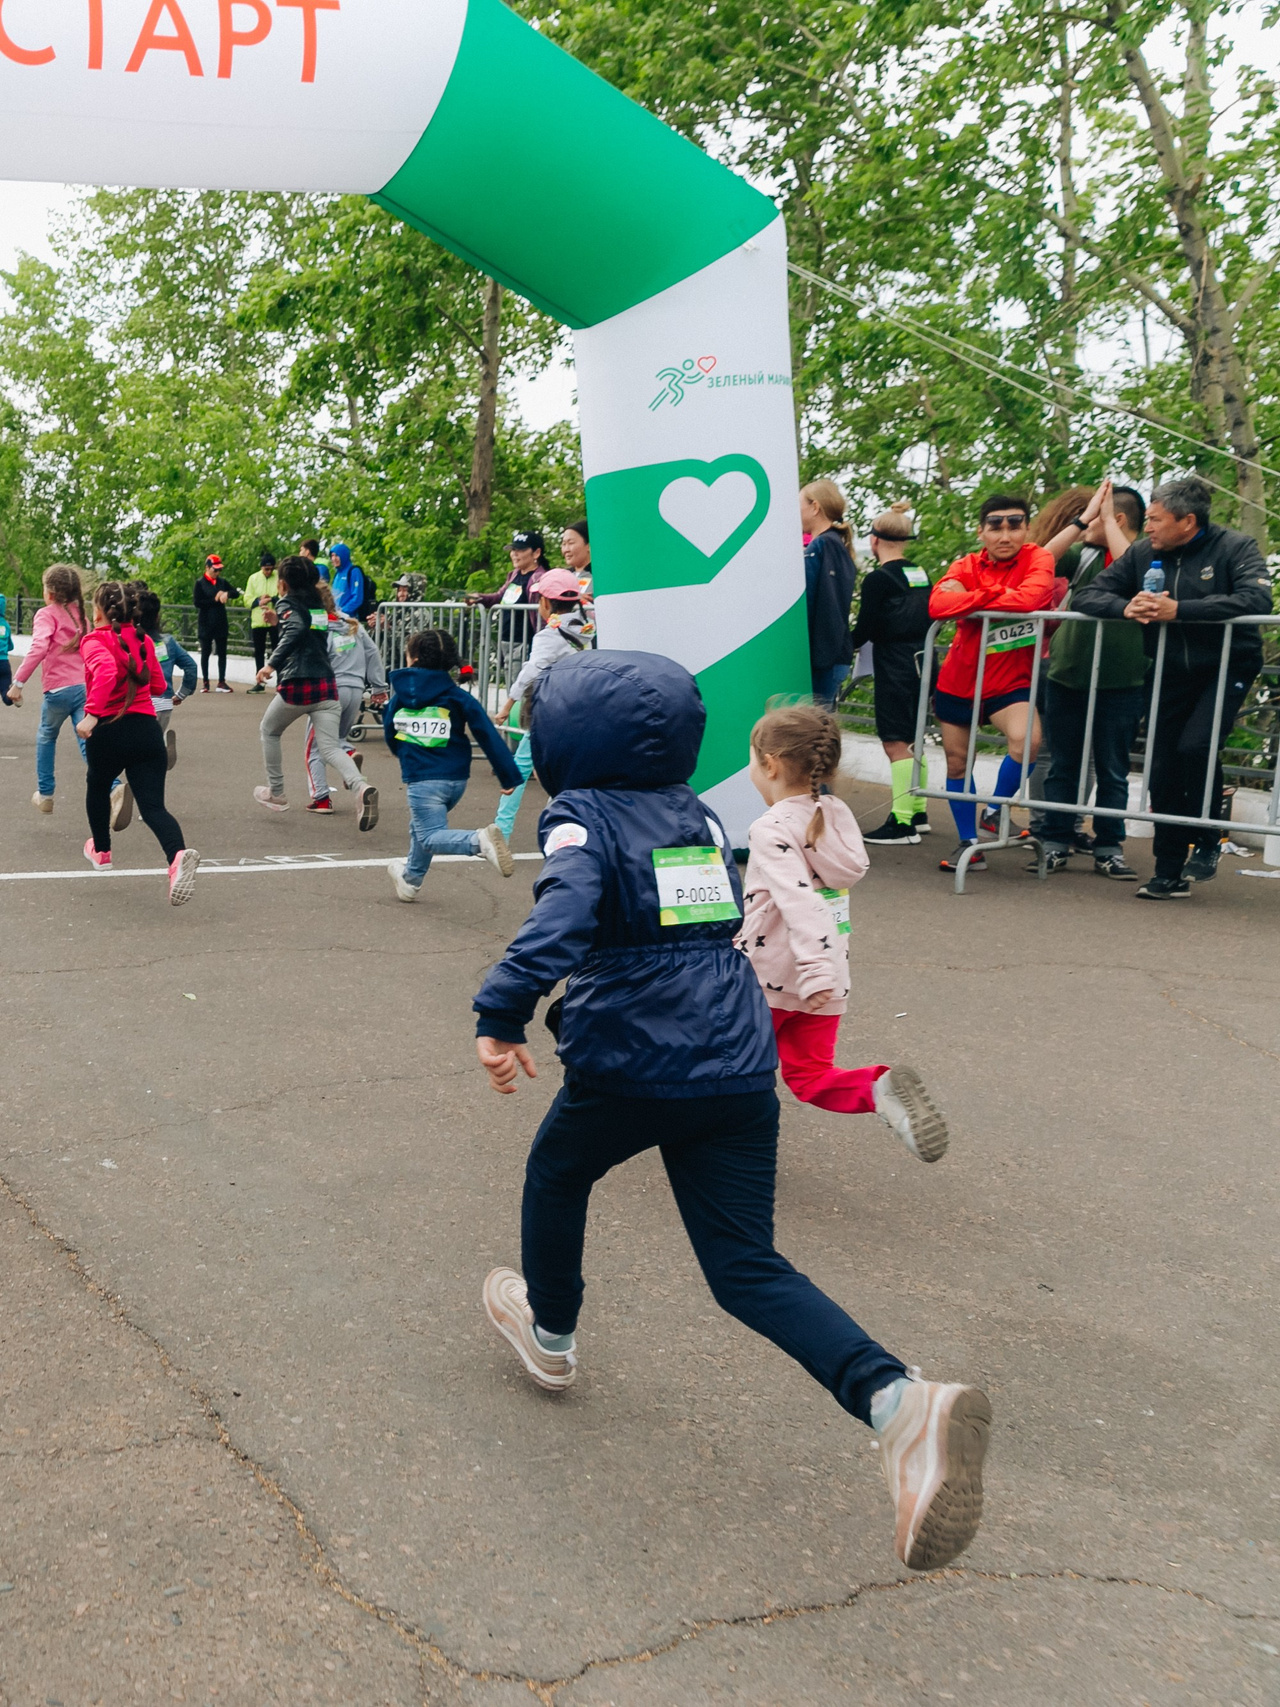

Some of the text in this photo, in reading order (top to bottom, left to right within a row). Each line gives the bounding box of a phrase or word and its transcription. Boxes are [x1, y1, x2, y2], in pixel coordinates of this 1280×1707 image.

[707, 371, 764, 389] ЗЕЛЕНЫЙ
[999, 622, 1035, 640] 0423
[411, 721, 447, 735] 0178
[676, 886, 722, 904] P-0025
